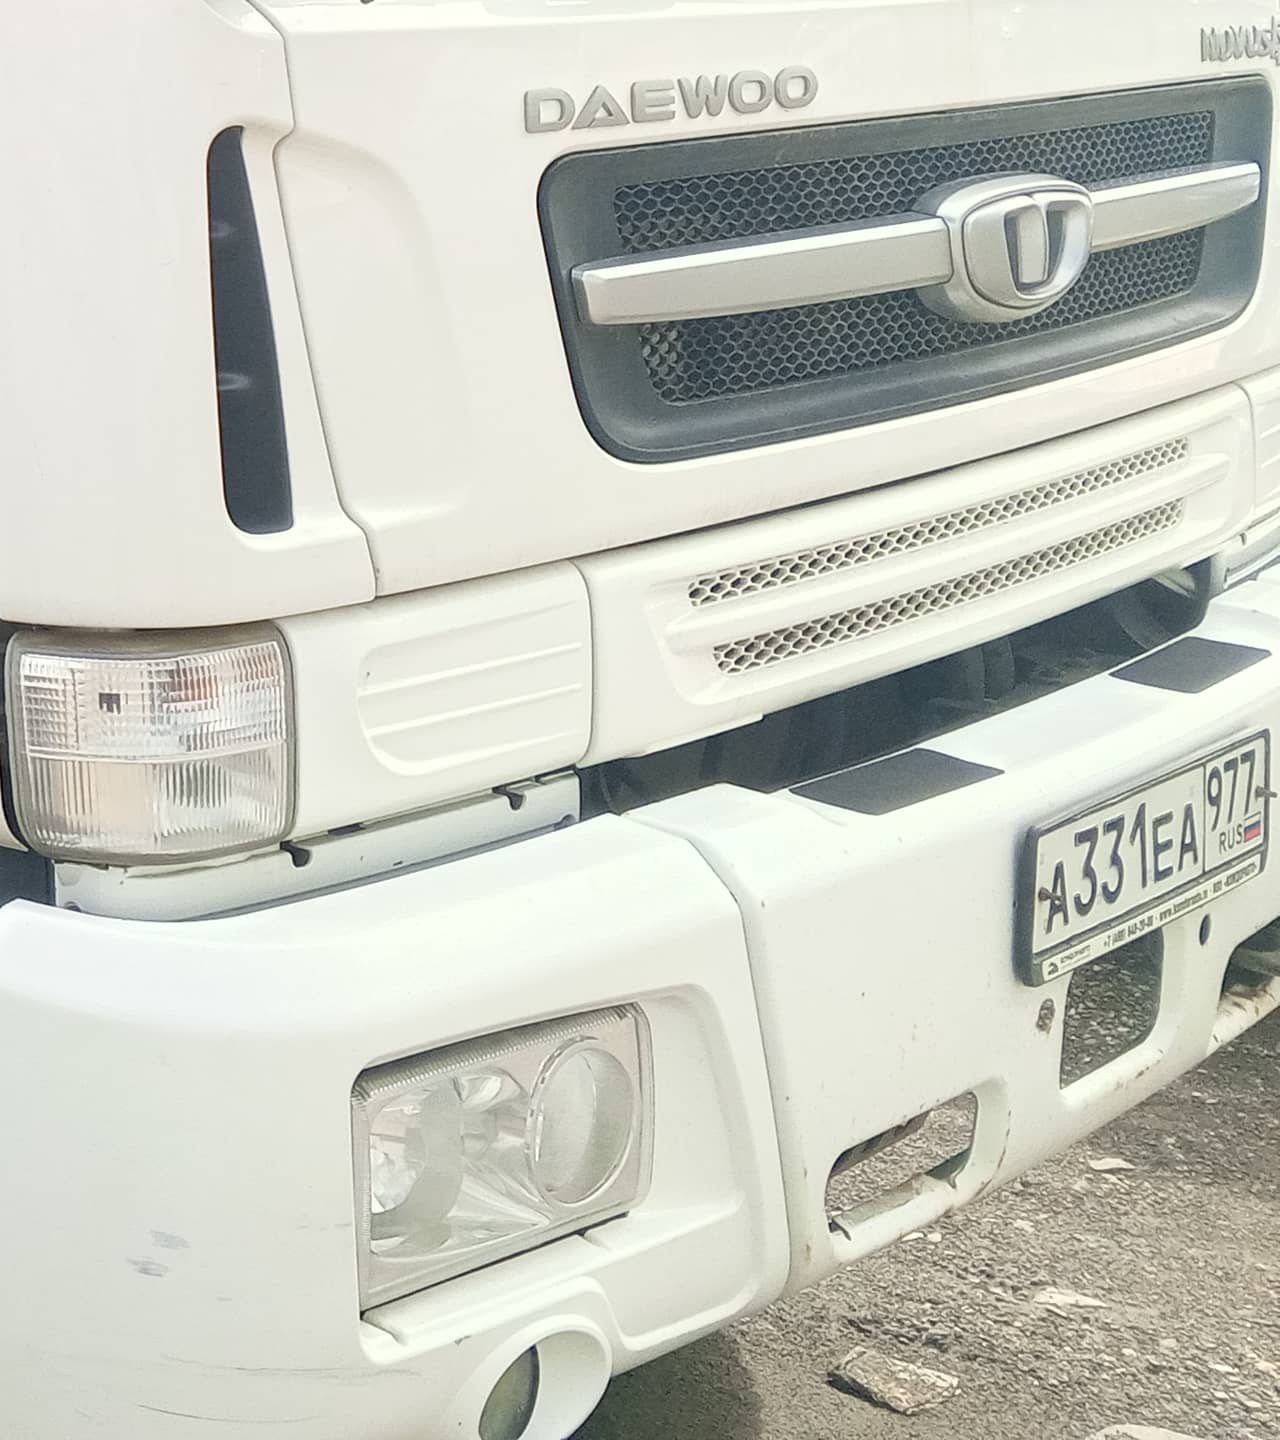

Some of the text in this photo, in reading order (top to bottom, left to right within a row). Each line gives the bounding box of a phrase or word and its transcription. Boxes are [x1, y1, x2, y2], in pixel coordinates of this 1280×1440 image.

[523, 65, 819, 134] DAEWOO
[1206, 748, 1257, 833] 977
[1217, 823, 1244, 856] RUS
